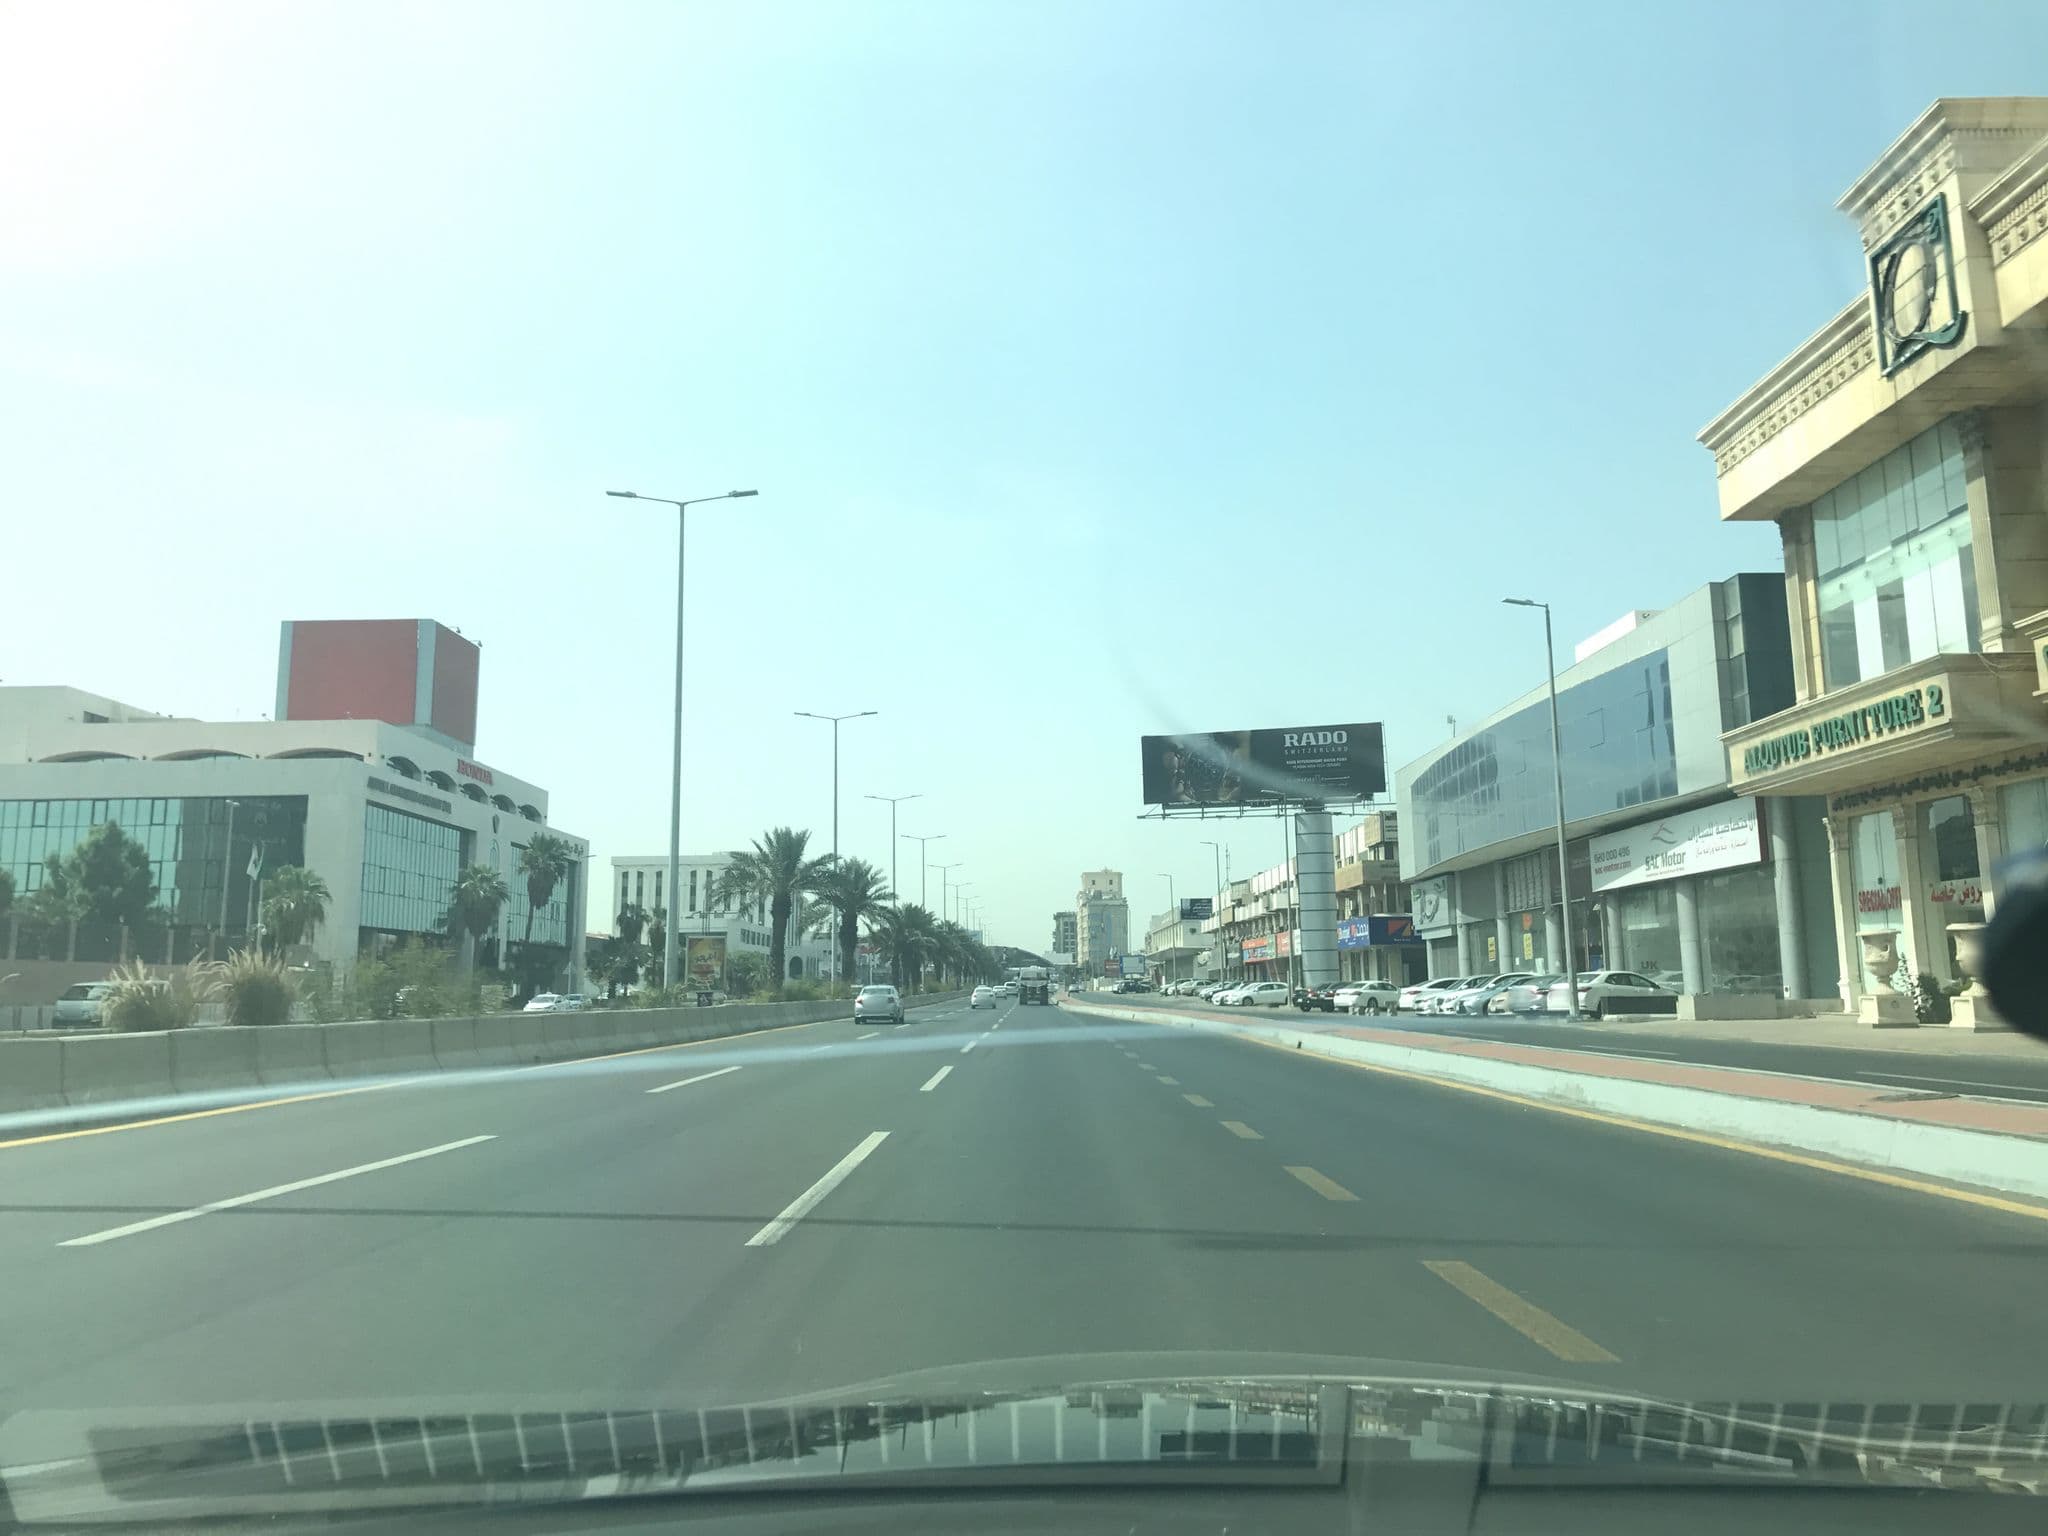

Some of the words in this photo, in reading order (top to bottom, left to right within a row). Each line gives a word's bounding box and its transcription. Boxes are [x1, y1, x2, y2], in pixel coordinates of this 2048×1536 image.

[1743, 729, 1811, 773] ALQUTUB
[1810, 689, 1924, 753] FURNITURE
[1925, 684, 1945, 716] 2
[1283, 730, 1348, 747] RADO
[1284, 746, 1348, 755] SWITZERLAND
[1660, 850, 1687, 869] Motor
[1858, 888, 1887, 913] SPECIAL
